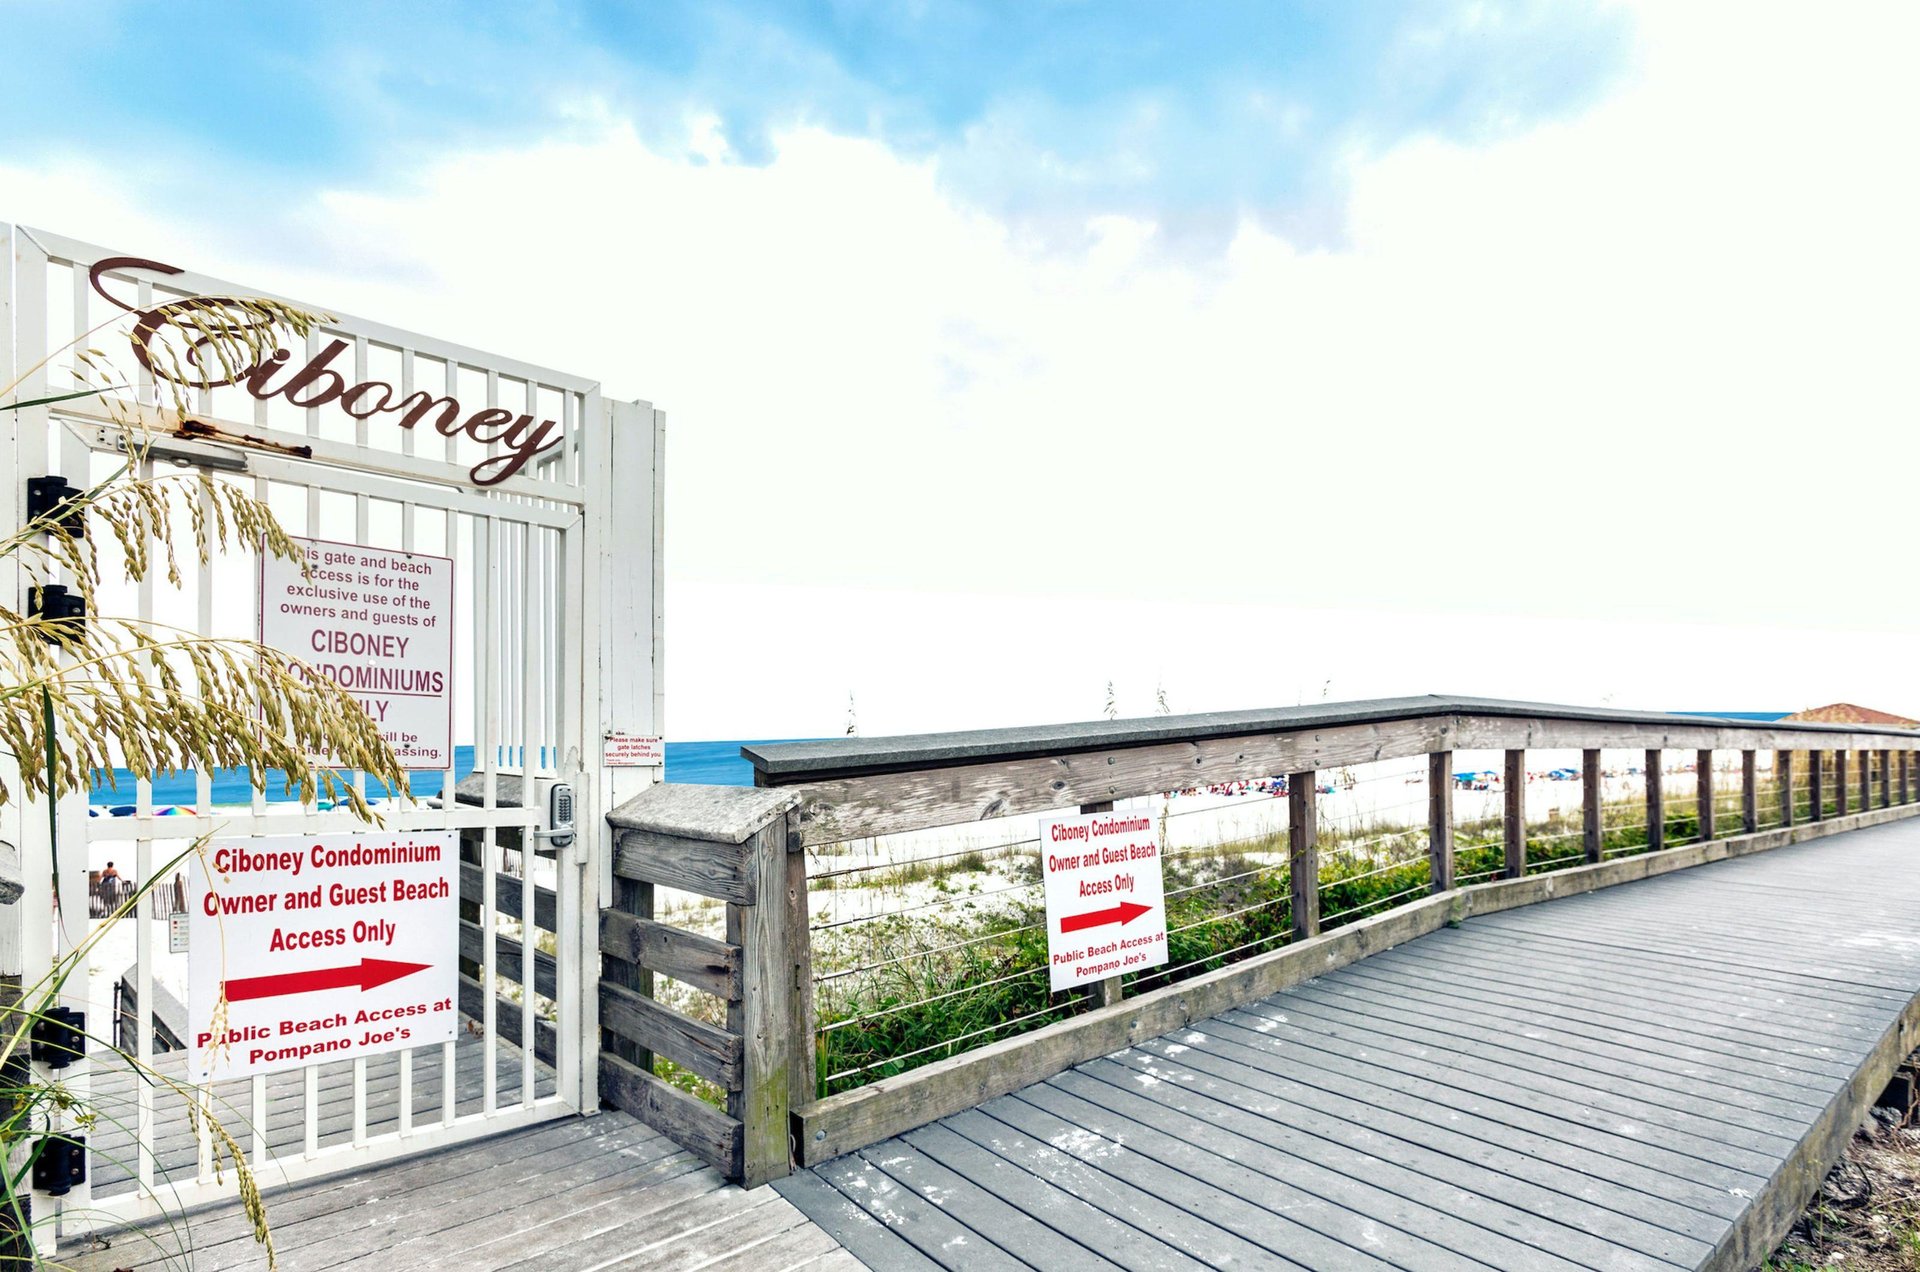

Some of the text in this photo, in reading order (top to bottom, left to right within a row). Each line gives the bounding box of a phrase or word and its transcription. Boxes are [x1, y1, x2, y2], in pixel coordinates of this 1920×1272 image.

[89, 256, 564, 486] Ciboney
[325, 553, 355, 566] gate
[360, 556, 387, 569] and
[392, 558, 432, 575] beach
[301, 568, 420, 591] access is for the
[287, 584, 431, 610] exclusive use of the
[280, 603, 436, 628] owners and guests of
[311, 628, 410, 658] CIBONEY
[402, 732, 418, 742] be
[1051, 815, 1150, 842] Ciboney Condominium
[215, 841, 441, 876] Ciboney Condominium
[1049, 841, 1156, 873] Owner and Guest Beach
[203, 876, 449, 917] Owner and Guest Beach
[1079, 873, 1134, 897] Access Only
[269, 919, 396, 952] Access Only
[1053, 931, 1164, 965] Public Beach Access at
[1076, 952, 1147, 977] Pompano Joe's
[197, 997, 452, 1048] Public Beach Access at
[249, 1027, 411, 1064] Pompano Joe's
